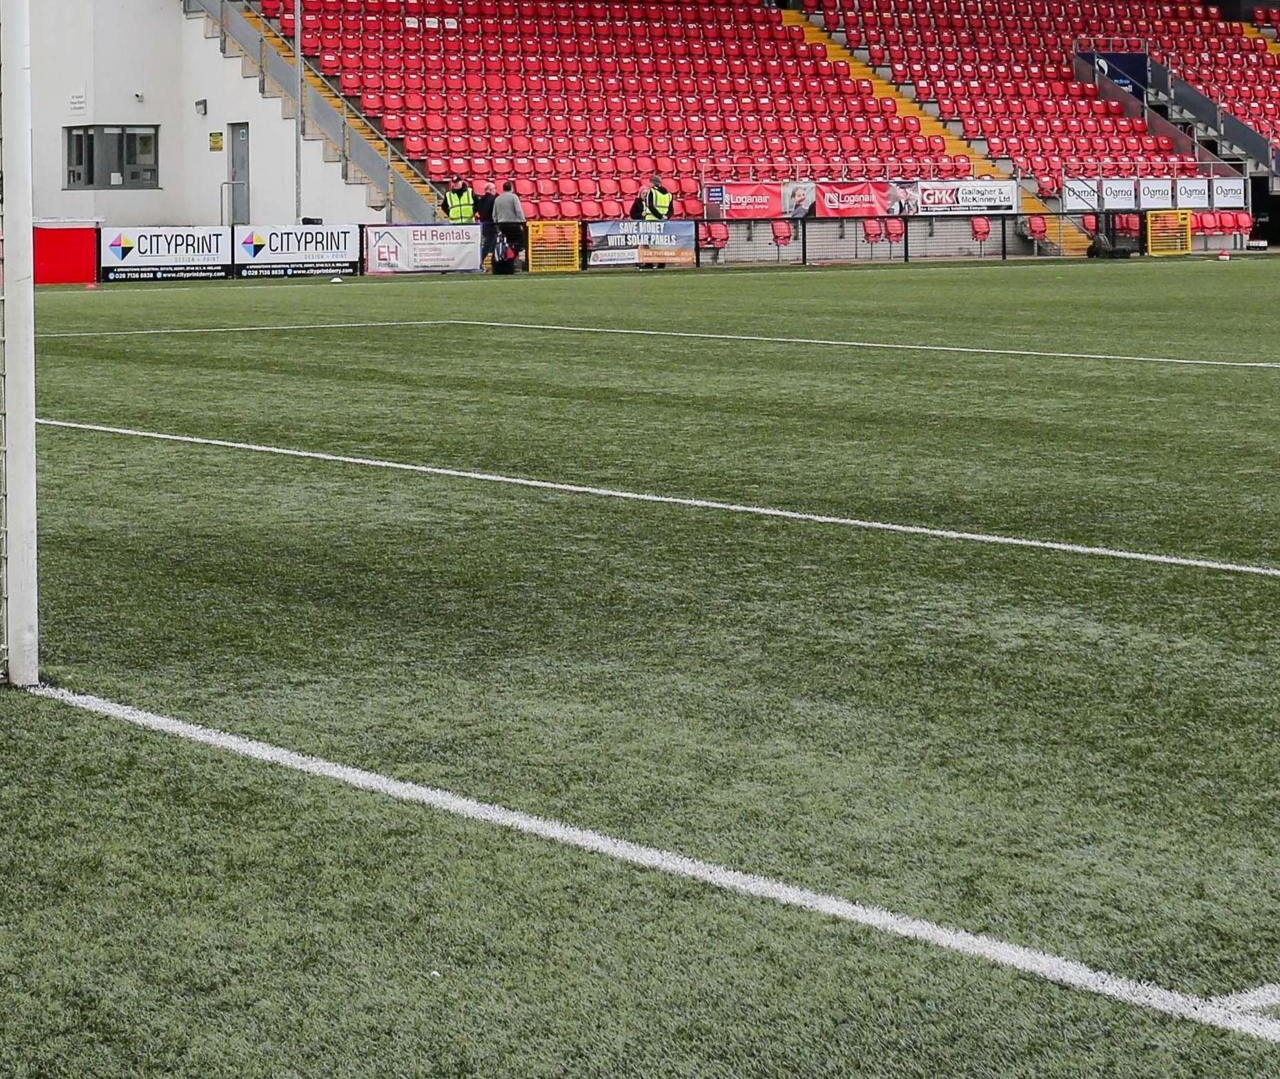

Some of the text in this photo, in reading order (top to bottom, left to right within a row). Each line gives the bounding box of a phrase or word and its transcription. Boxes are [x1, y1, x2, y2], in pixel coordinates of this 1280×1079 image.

[922, 189, 954, 204] GMK
[961, 188, 996, 196] Gallagher
[1105, 186, 1133, 199] Ogma
[1142, 186, 1169, 199] Ogma
[1179, 185, 1206, 198] Ogma
[1215, 185, 1242, 198] Ogma
[730, 194, 770, 205] Loganair
[619, 221, 665, 233] SAVE MONEY
[412, 229, 471, 241] EH Rentals
[607, 234, 677, 247] WITH SOLAR PANELS
[137, 233, 223, 256] CITYPRINT
[269, 231, 351, 254] CITYPRINT
[378, 245, 399, 261] EH
